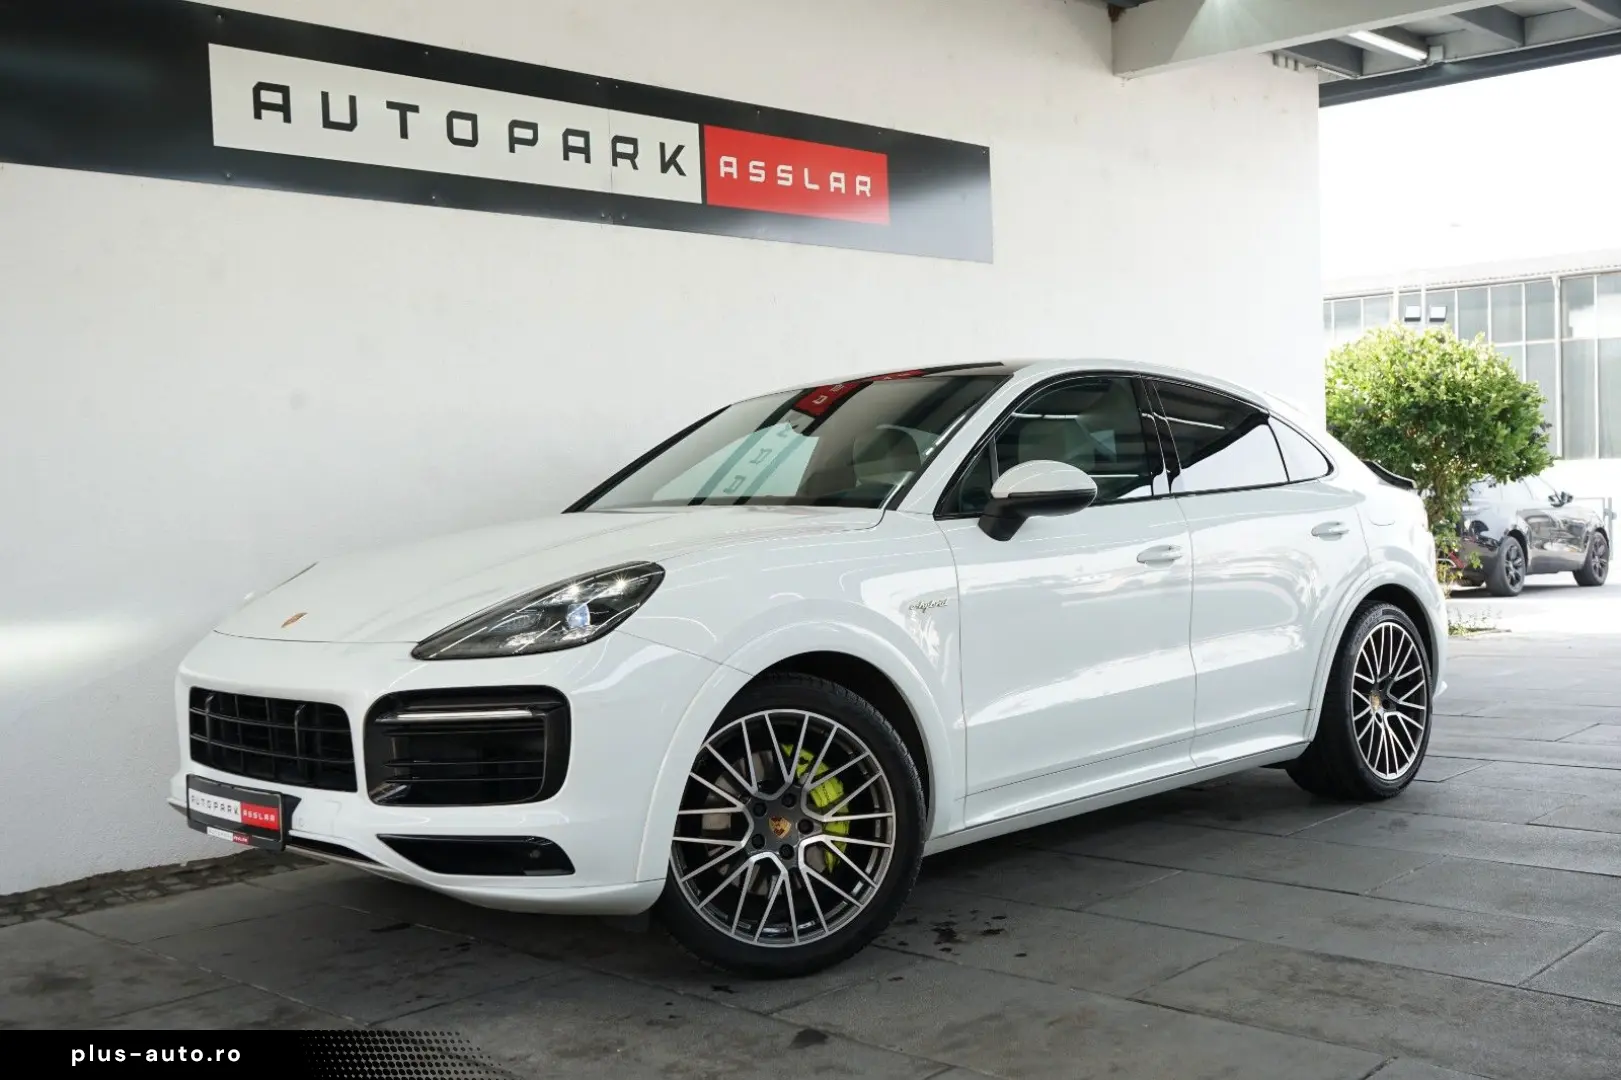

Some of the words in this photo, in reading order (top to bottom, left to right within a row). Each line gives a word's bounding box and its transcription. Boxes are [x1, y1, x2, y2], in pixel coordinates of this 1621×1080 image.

[252, 81, 687, 177] AUTOPARK
[719, 155, 872, 197] ASSLAR
[191, 795, 239, 815] AUTOPARK
[243, 809, 275, 822] ASSLAR
